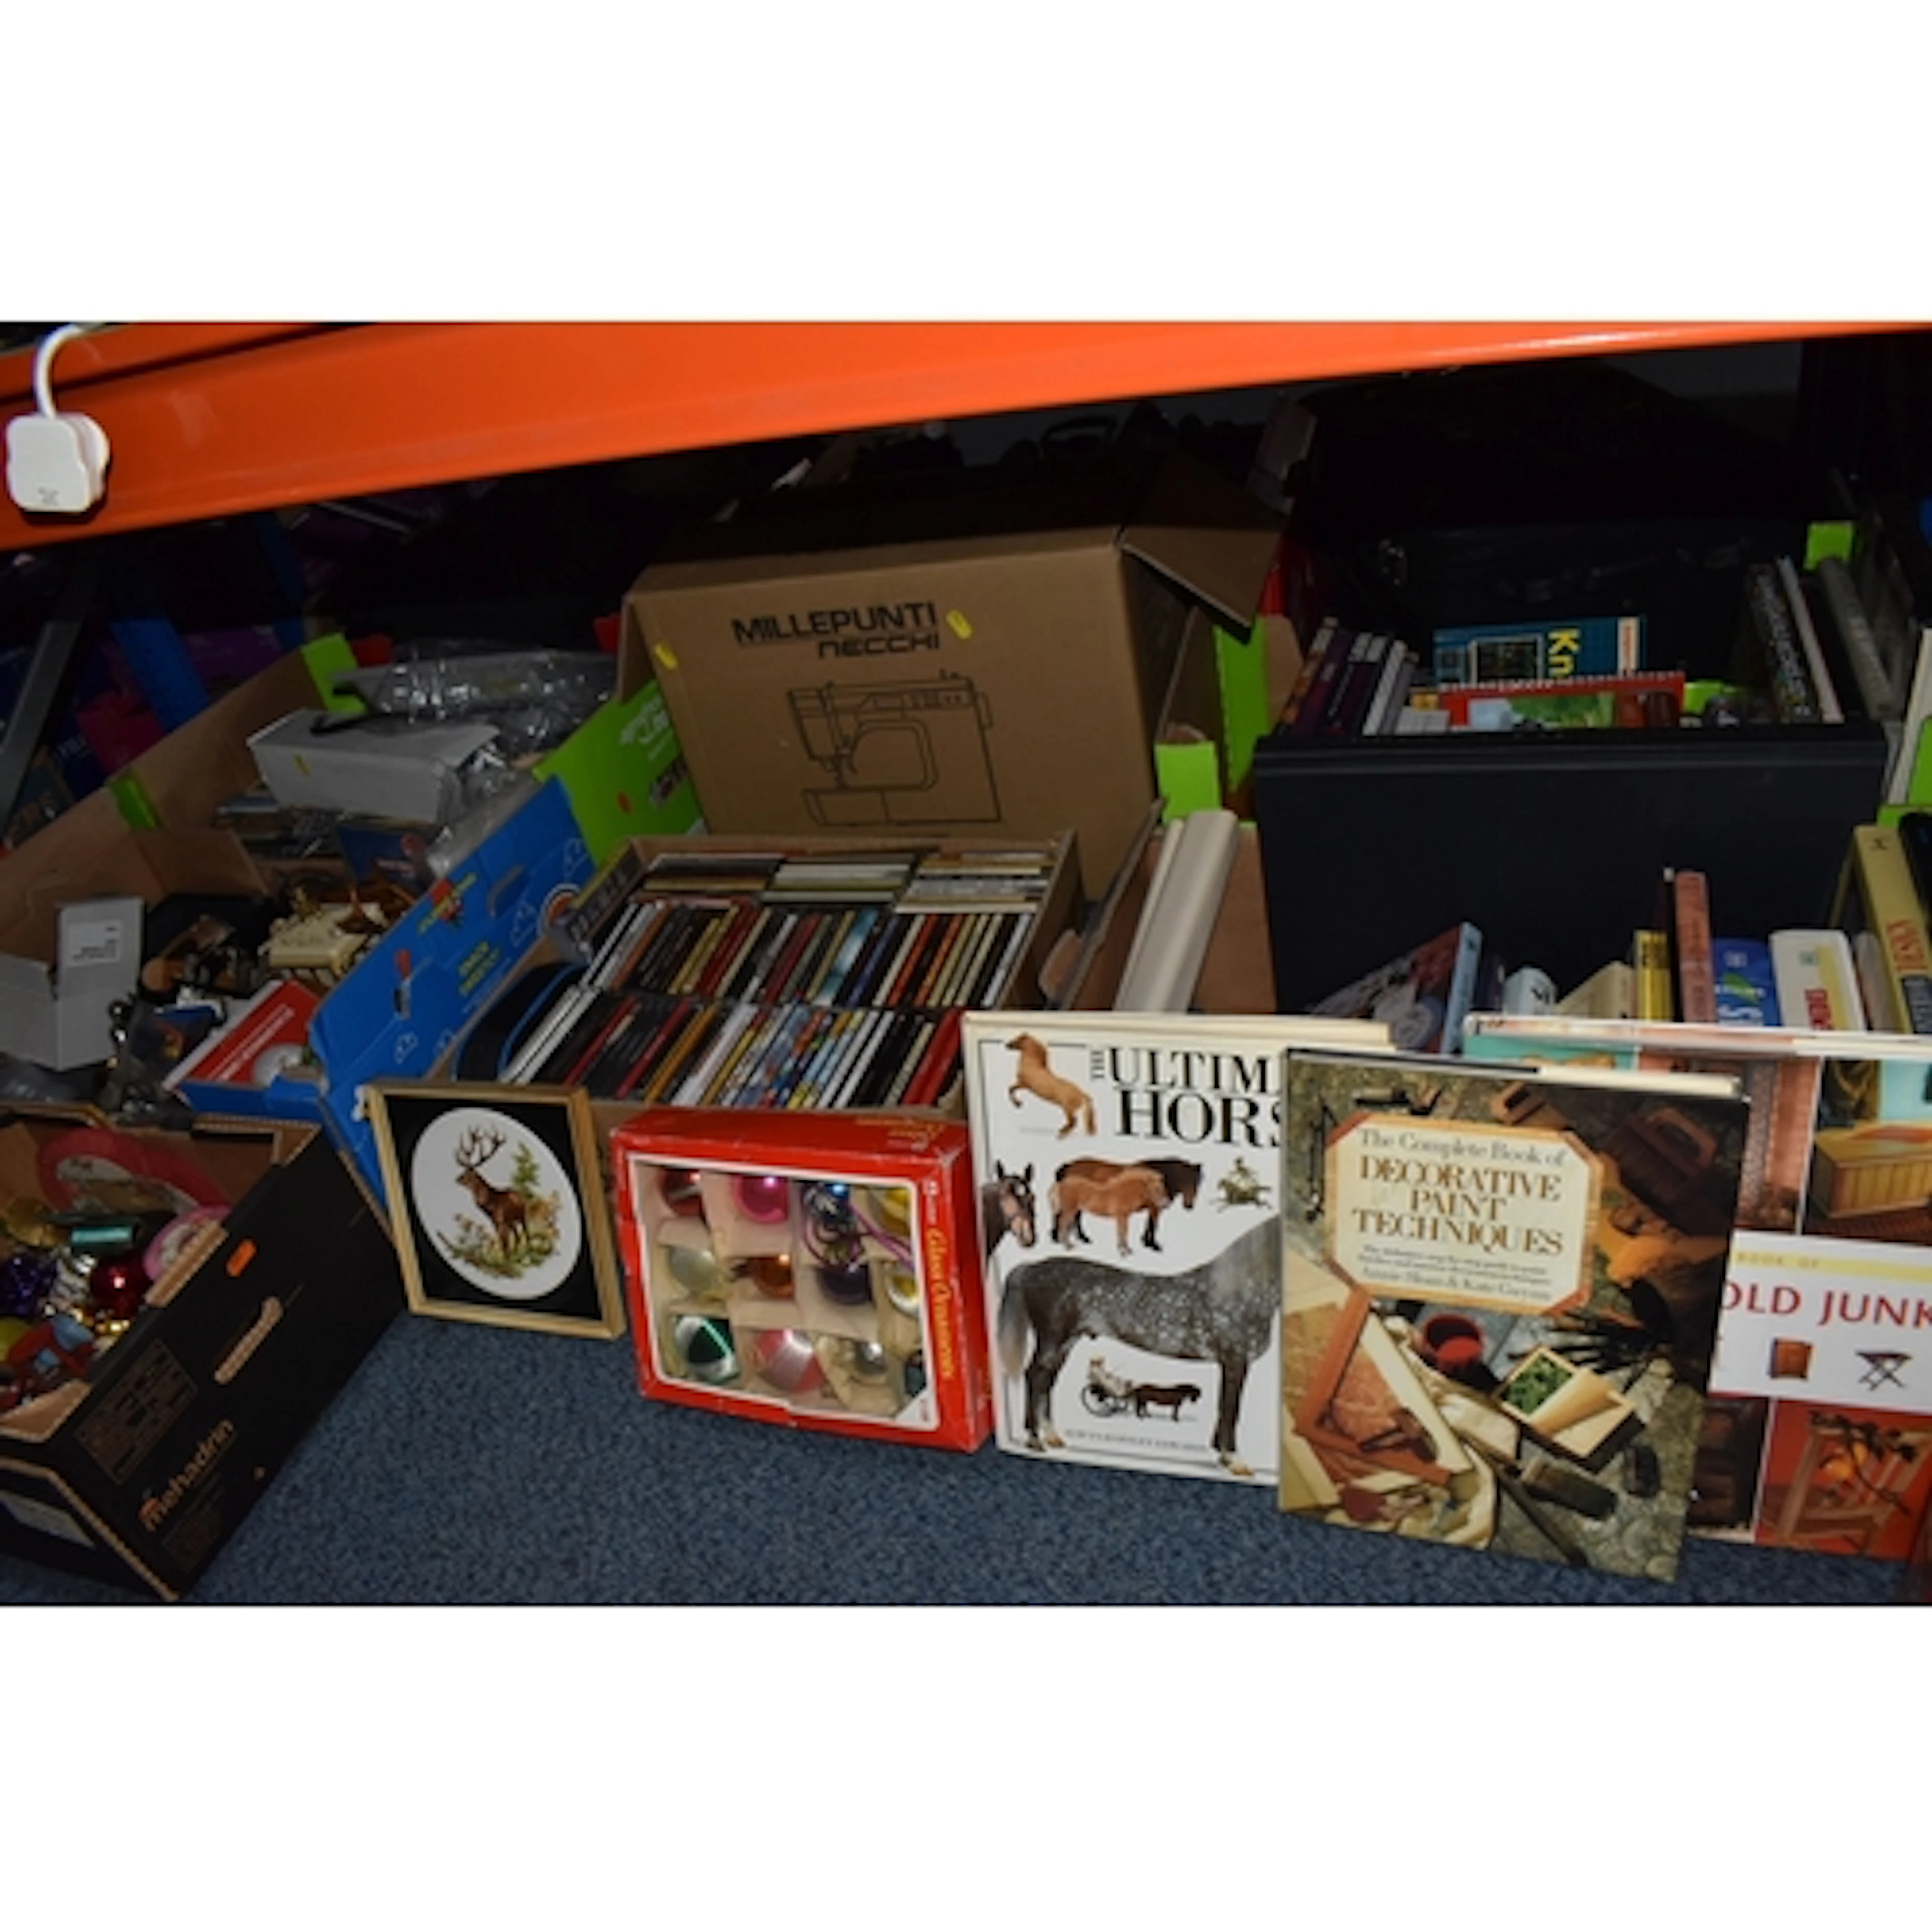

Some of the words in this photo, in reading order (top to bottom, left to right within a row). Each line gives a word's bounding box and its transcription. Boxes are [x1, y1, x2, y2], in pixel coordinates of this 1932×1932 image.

[732, 601, 936, 644] MILLEPUNTI
[1092, 1050, 1105, 1080] THE
[1109, 1048, 1281, 1095] ULTIM
[1360, 1129, 1396, 1147] The
[1398, 1132, 1488, 1159] Complete
[1491, 1142, 1541, 1165] Book
[1544, 1148, 1566, 1168] of
[1360, 1156, 1561, 1201] DECORATIVE
[1410, 1189, 1507, 1221] PAINT
[1351, 1209, 1564, 1255] TECHNIQUES
[1721, 1280, 1802, 1315] OLD
[1817, 1290, 1932, 1329] JUNK
